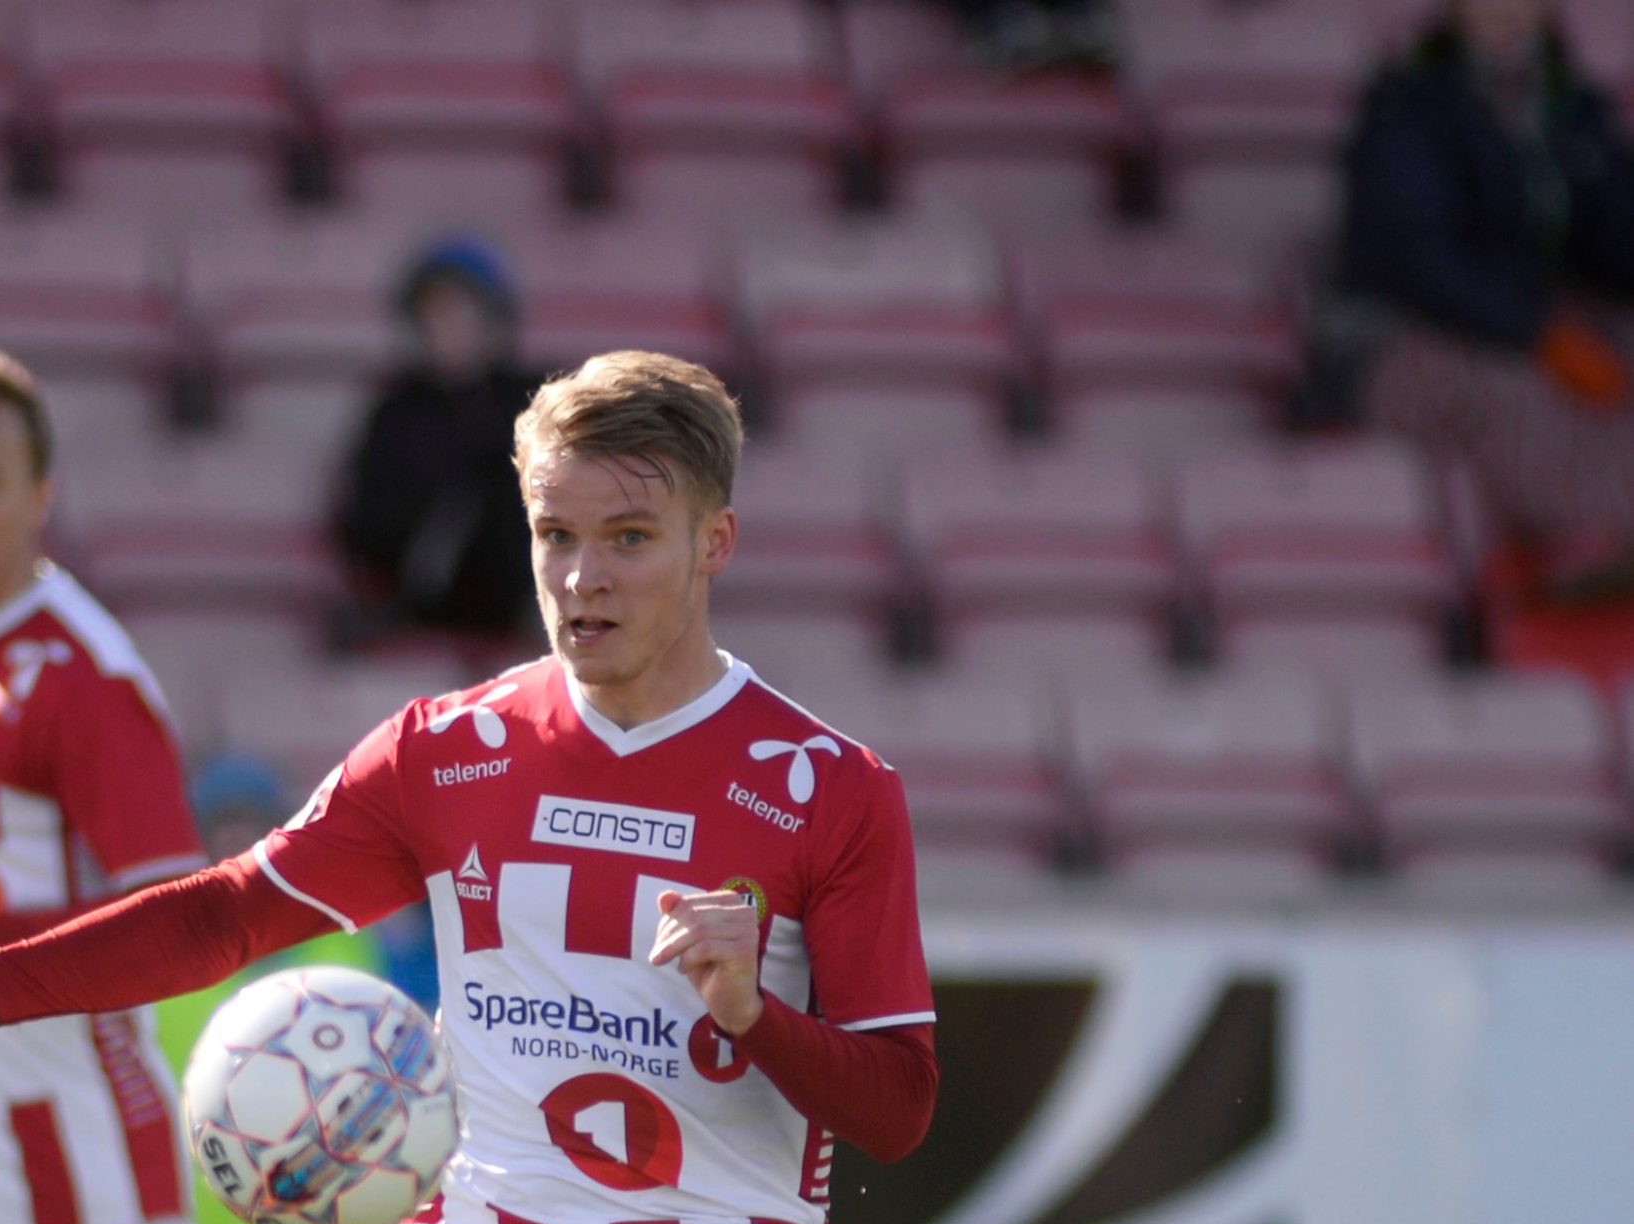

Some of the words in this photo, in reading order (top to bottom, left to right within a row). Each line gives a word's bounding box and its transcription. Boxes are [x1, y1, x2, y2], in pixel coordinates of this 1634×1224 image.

[432, 756, 512, 787] telenor
[726, 781, 804, 833] telenor
[456, 881, 493, 901] SELECT
[464, 981, 679, 1048] SpareBank
[512, 1036, 680, 1079] NORD-NORGE
